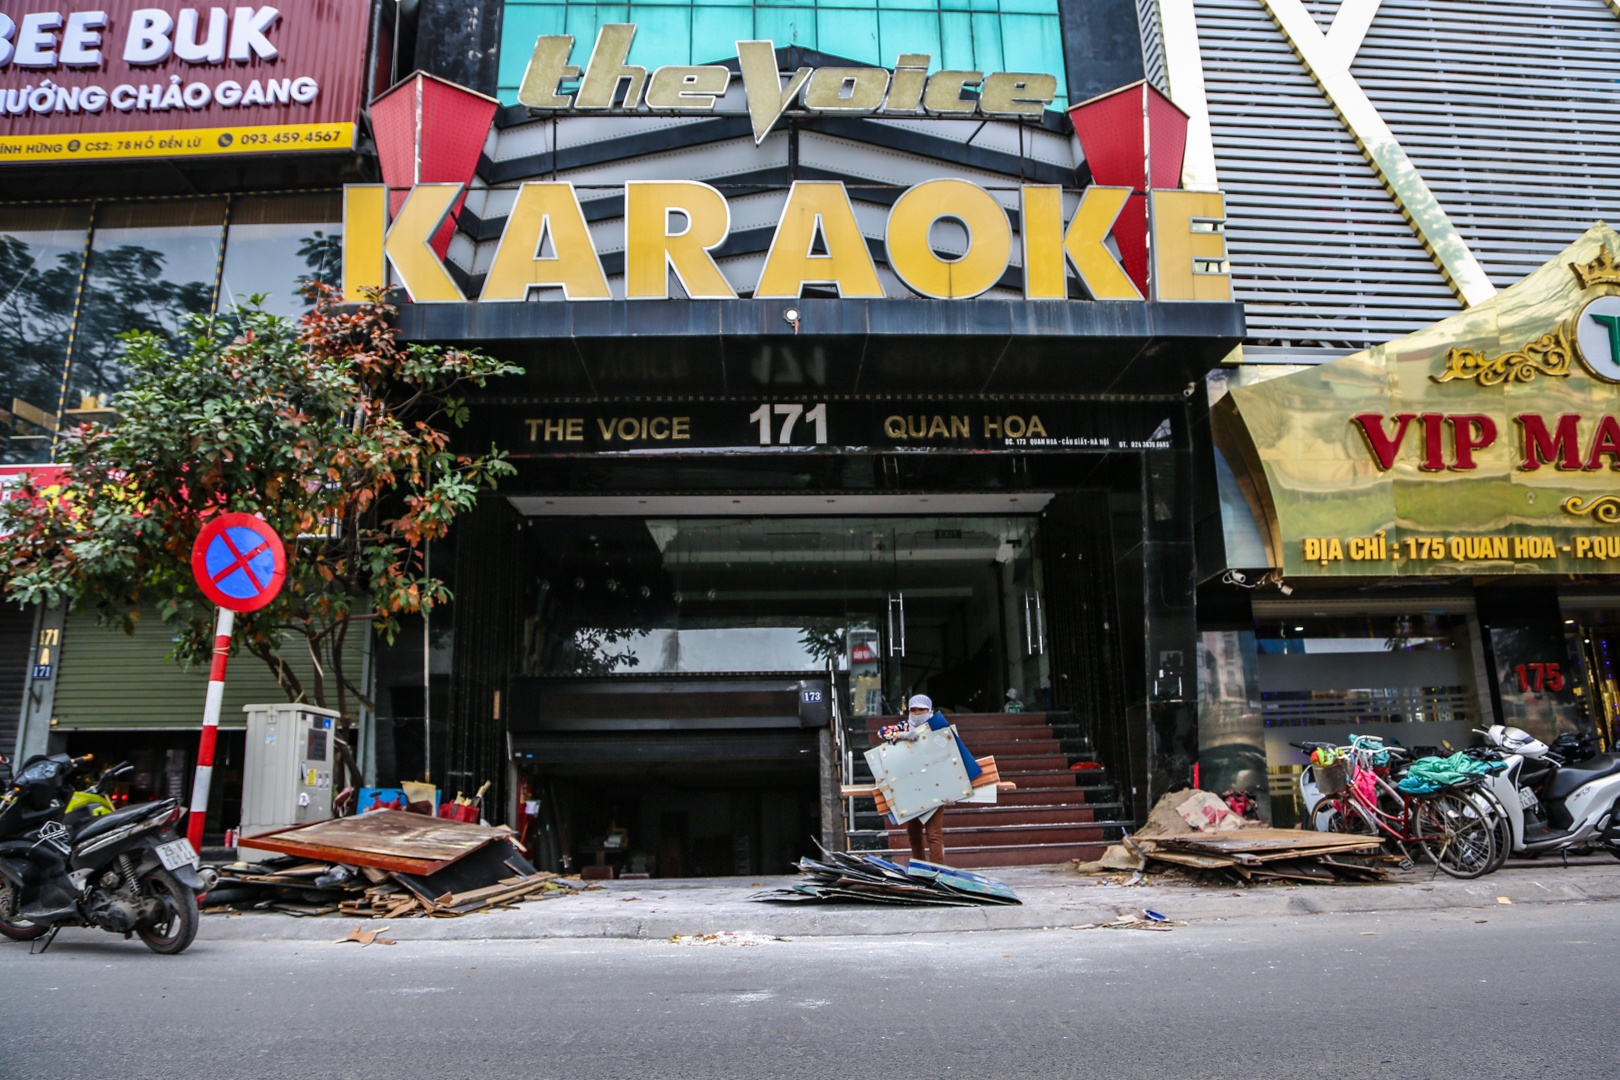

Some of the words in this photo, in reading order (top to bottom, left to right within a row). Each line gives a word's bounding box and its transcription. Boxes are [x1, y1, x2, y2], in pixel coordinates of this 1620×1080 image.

[518, 23, 731, 112] the
[111, 74, 212, 112] CHẢO
[214, 76, 319, 107] GANG
[240, 130, 341, 145] 093.459.4567
[342, 178, 1236, 305] KARAOKE
[524, 417, 584, 441] THE
[597, 416, 691, 441] VOICE
[750, 403, 827, 444] 171
[884, 415, 970, 439] QUAN
[984, 415, 1048, 438] HOA
[1351, 412, 1498, 472] VIP
[1303, 537, 1344, 566] ĐỊA
[1349, 530, 1387, 561] CHỈ
[1406, 537, 1445, 560] 175
[1450, 536, 1509, 562] QUAN
[1513, 536, 1556, 559] HOA
[39, 628, 60, 646] 171
[40, 647, 50, 665] A
[33, 665, 51, 677] 171
[1514, 662, 1564, 693] 175
[804, 690, 821, 702] 173
